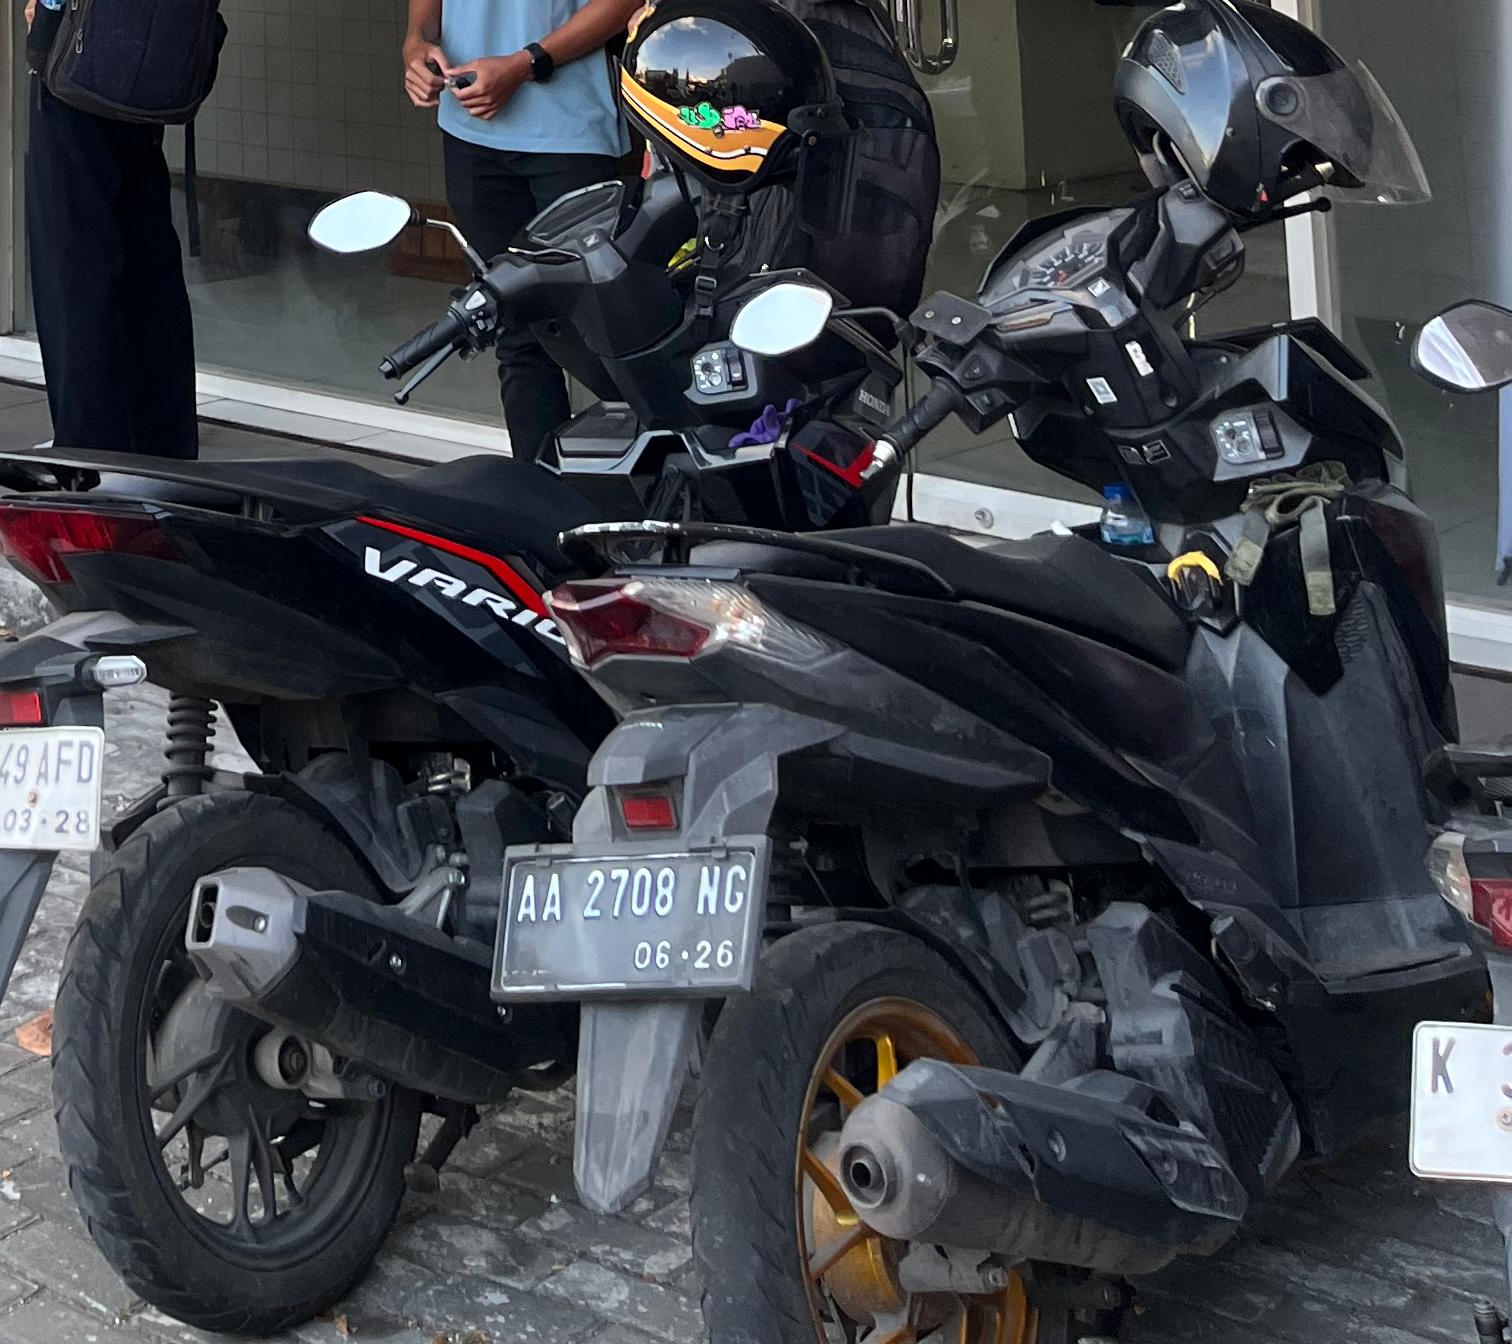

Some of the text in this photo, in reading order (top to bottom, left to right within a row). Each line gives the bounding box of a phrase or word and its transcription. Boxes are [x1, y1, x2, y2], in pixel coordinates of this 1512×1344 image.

[35, 740, 95, 786] AFD
[517, 864, 747, 922] AA 2708 NG
[1431, 1037, 1456, 1094] K
